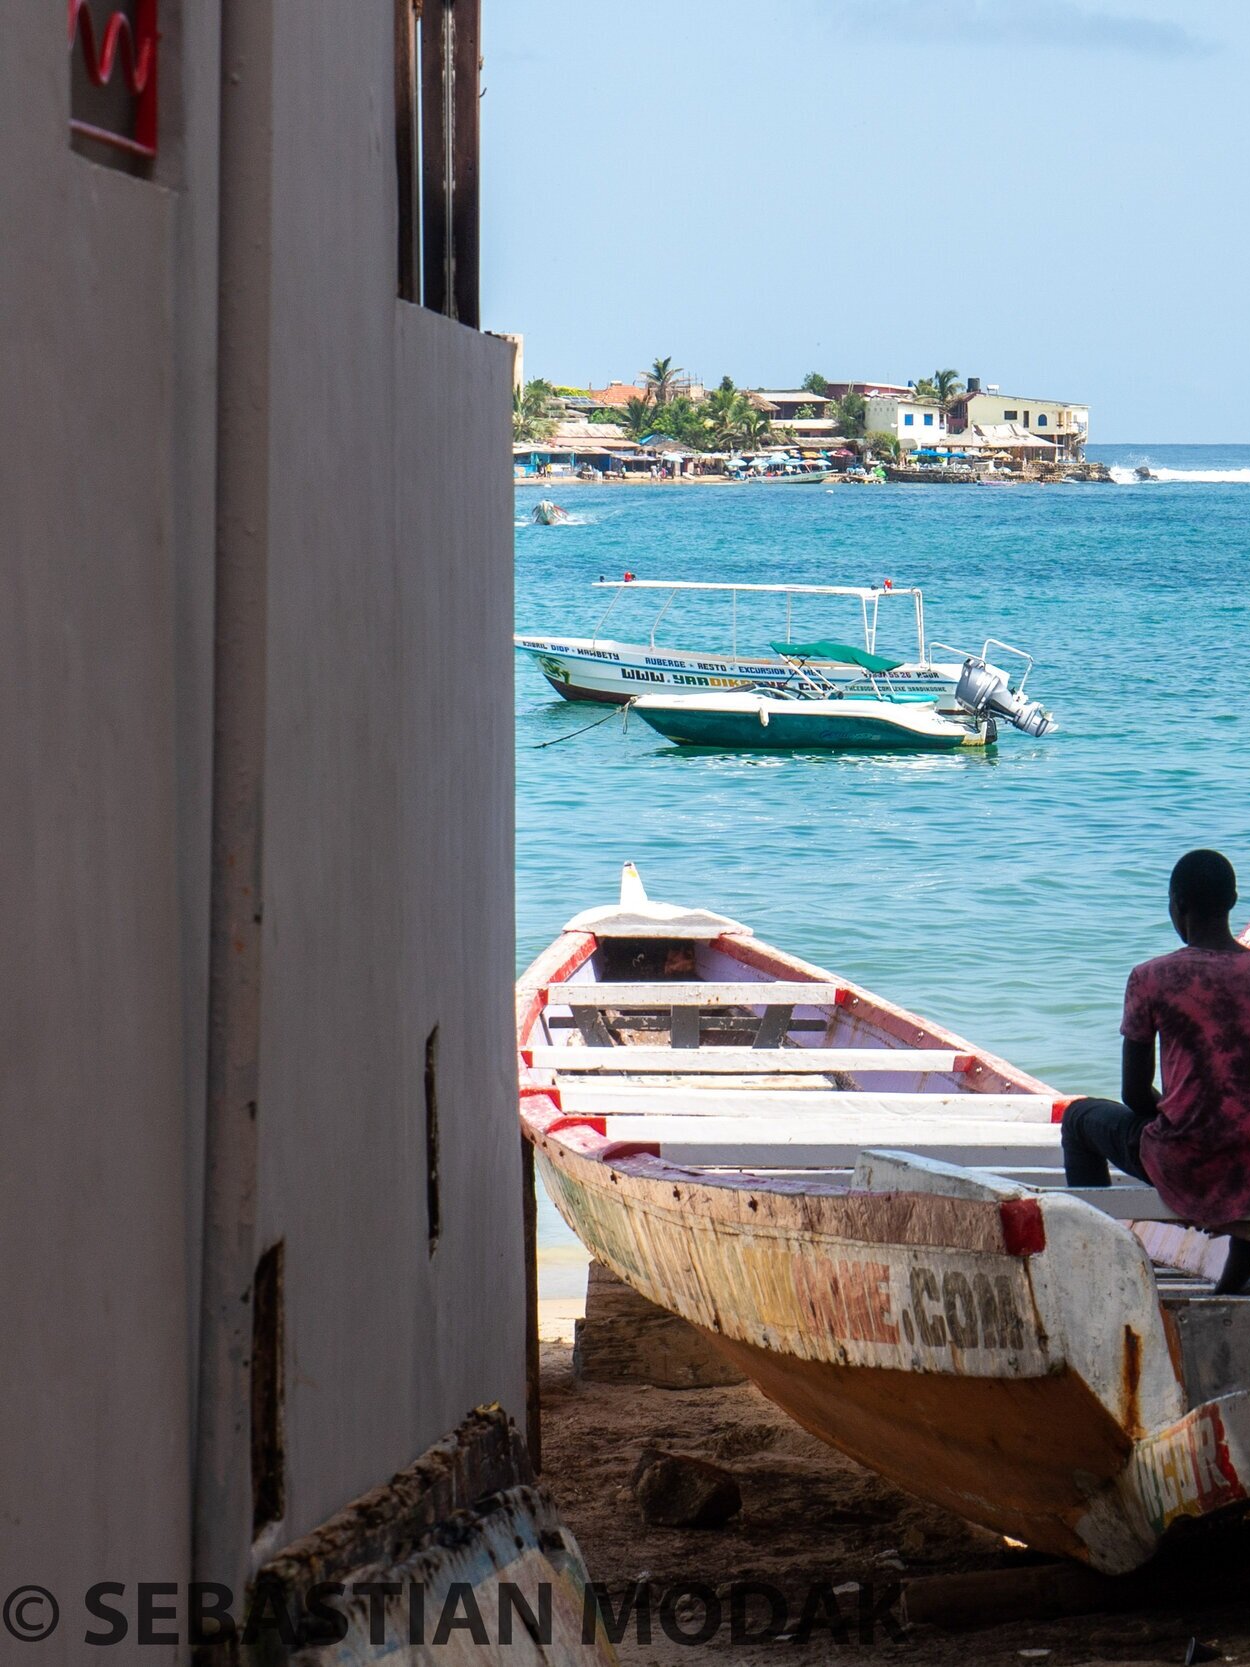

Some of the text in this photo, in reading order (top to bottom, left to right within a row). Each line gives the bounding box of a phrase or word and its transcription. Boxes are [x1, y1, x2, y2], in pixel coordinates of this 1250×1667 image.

[551, 644, 570, 653] DIOP
[645, 657, 686, 668] AUBERGE
[698, 662, 727, 672] RESTO
[738, 666, 786, 676] EXCURSION
